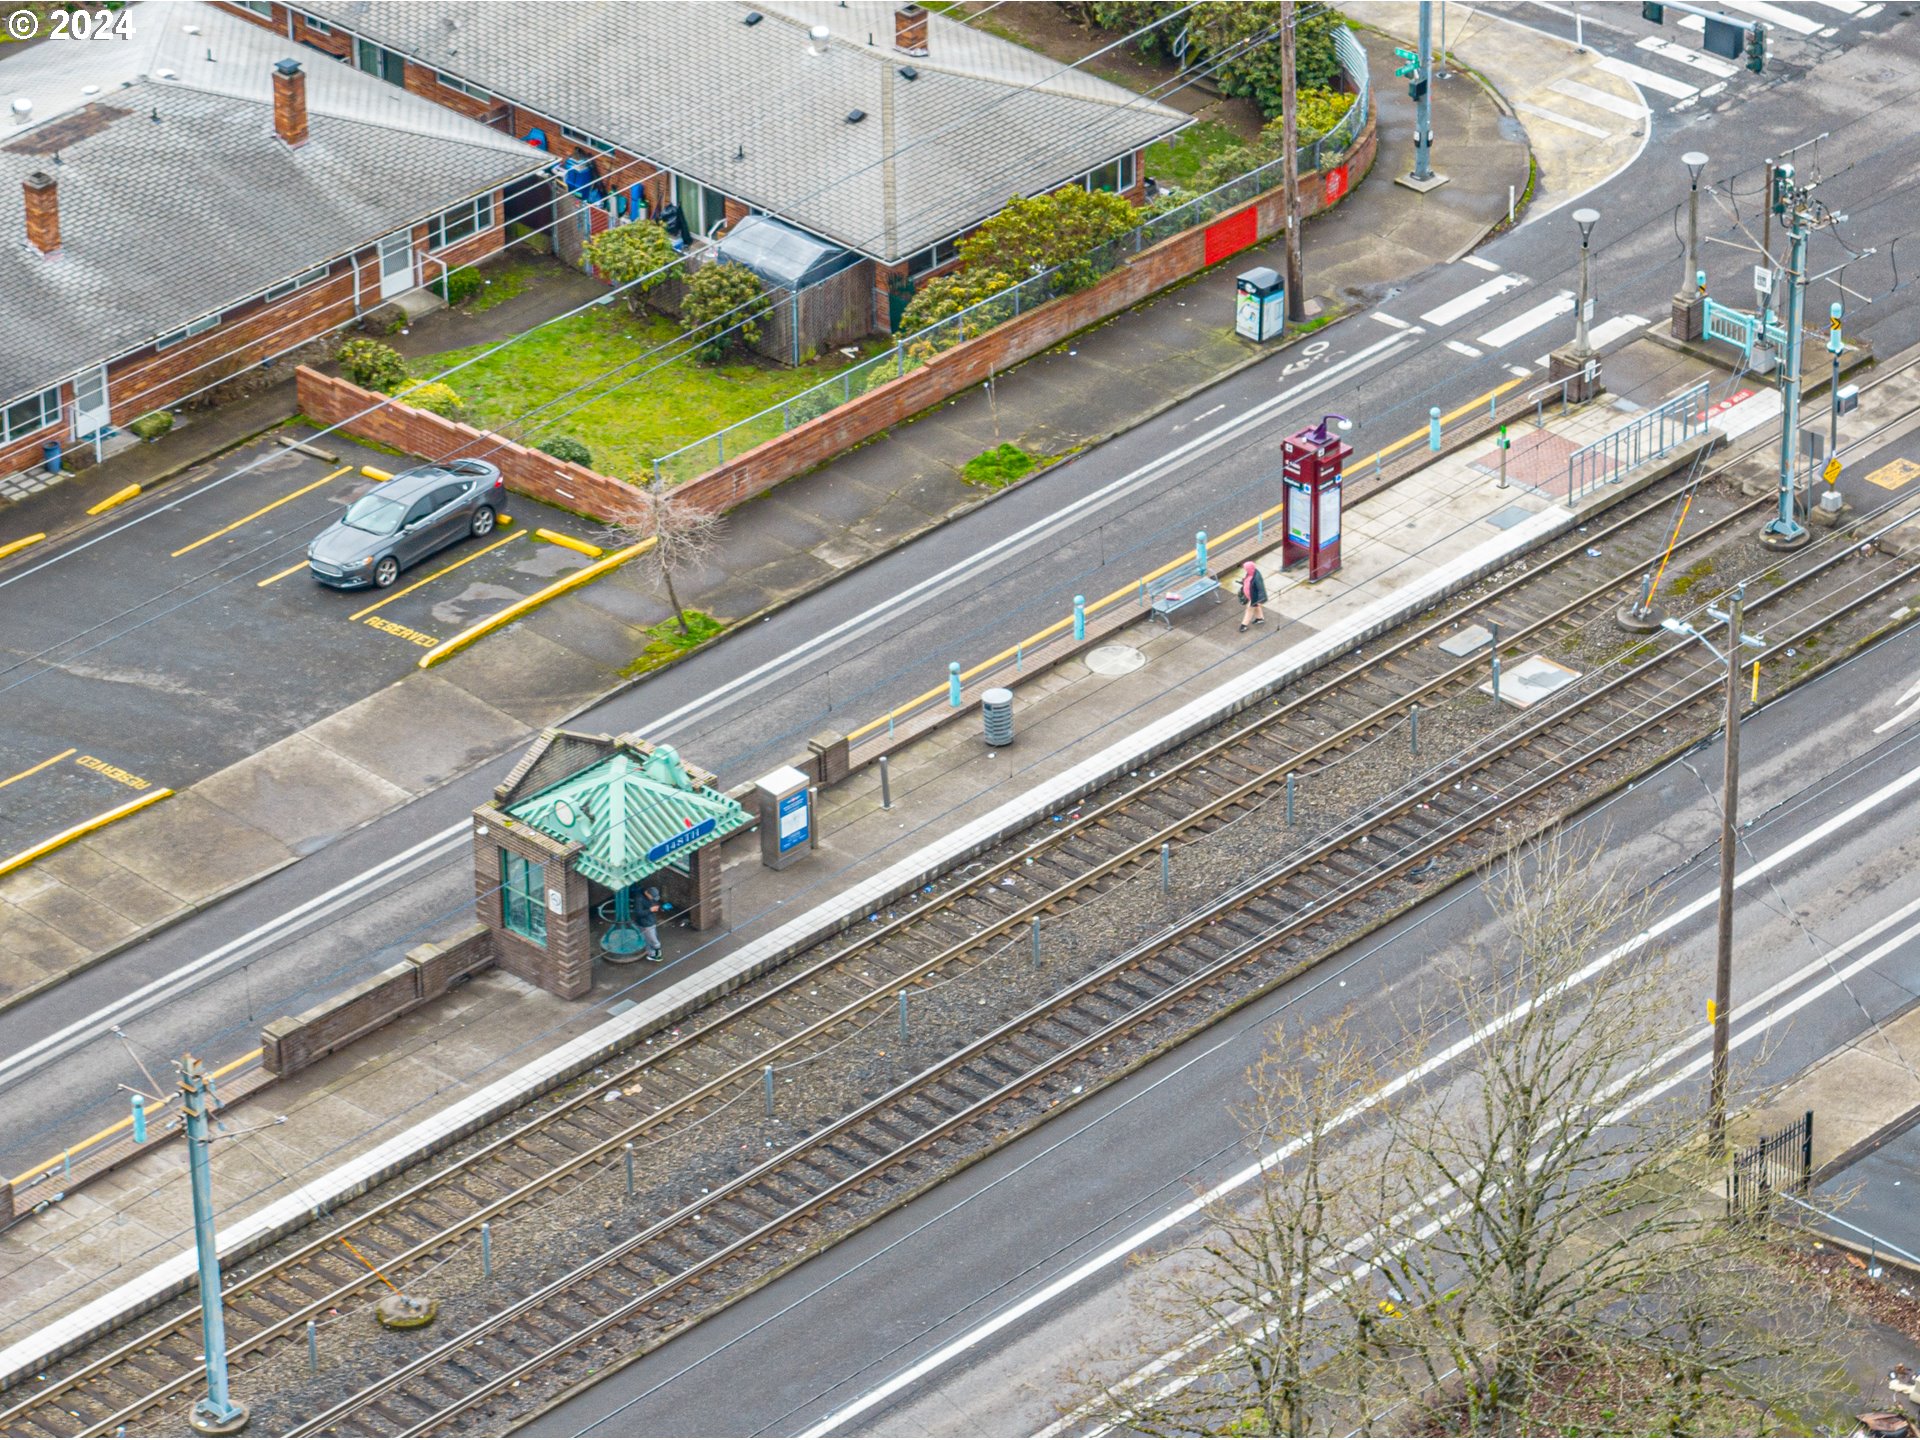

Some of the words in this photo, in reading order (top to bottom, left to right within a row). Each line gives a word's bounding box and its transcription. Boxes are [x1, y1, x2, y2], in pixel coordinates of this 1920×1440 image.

[363, 616, 439, 648] RESERVED
[76, 755, 152, 790] RESERVED
[665, 827, 700, 852] 148TH
